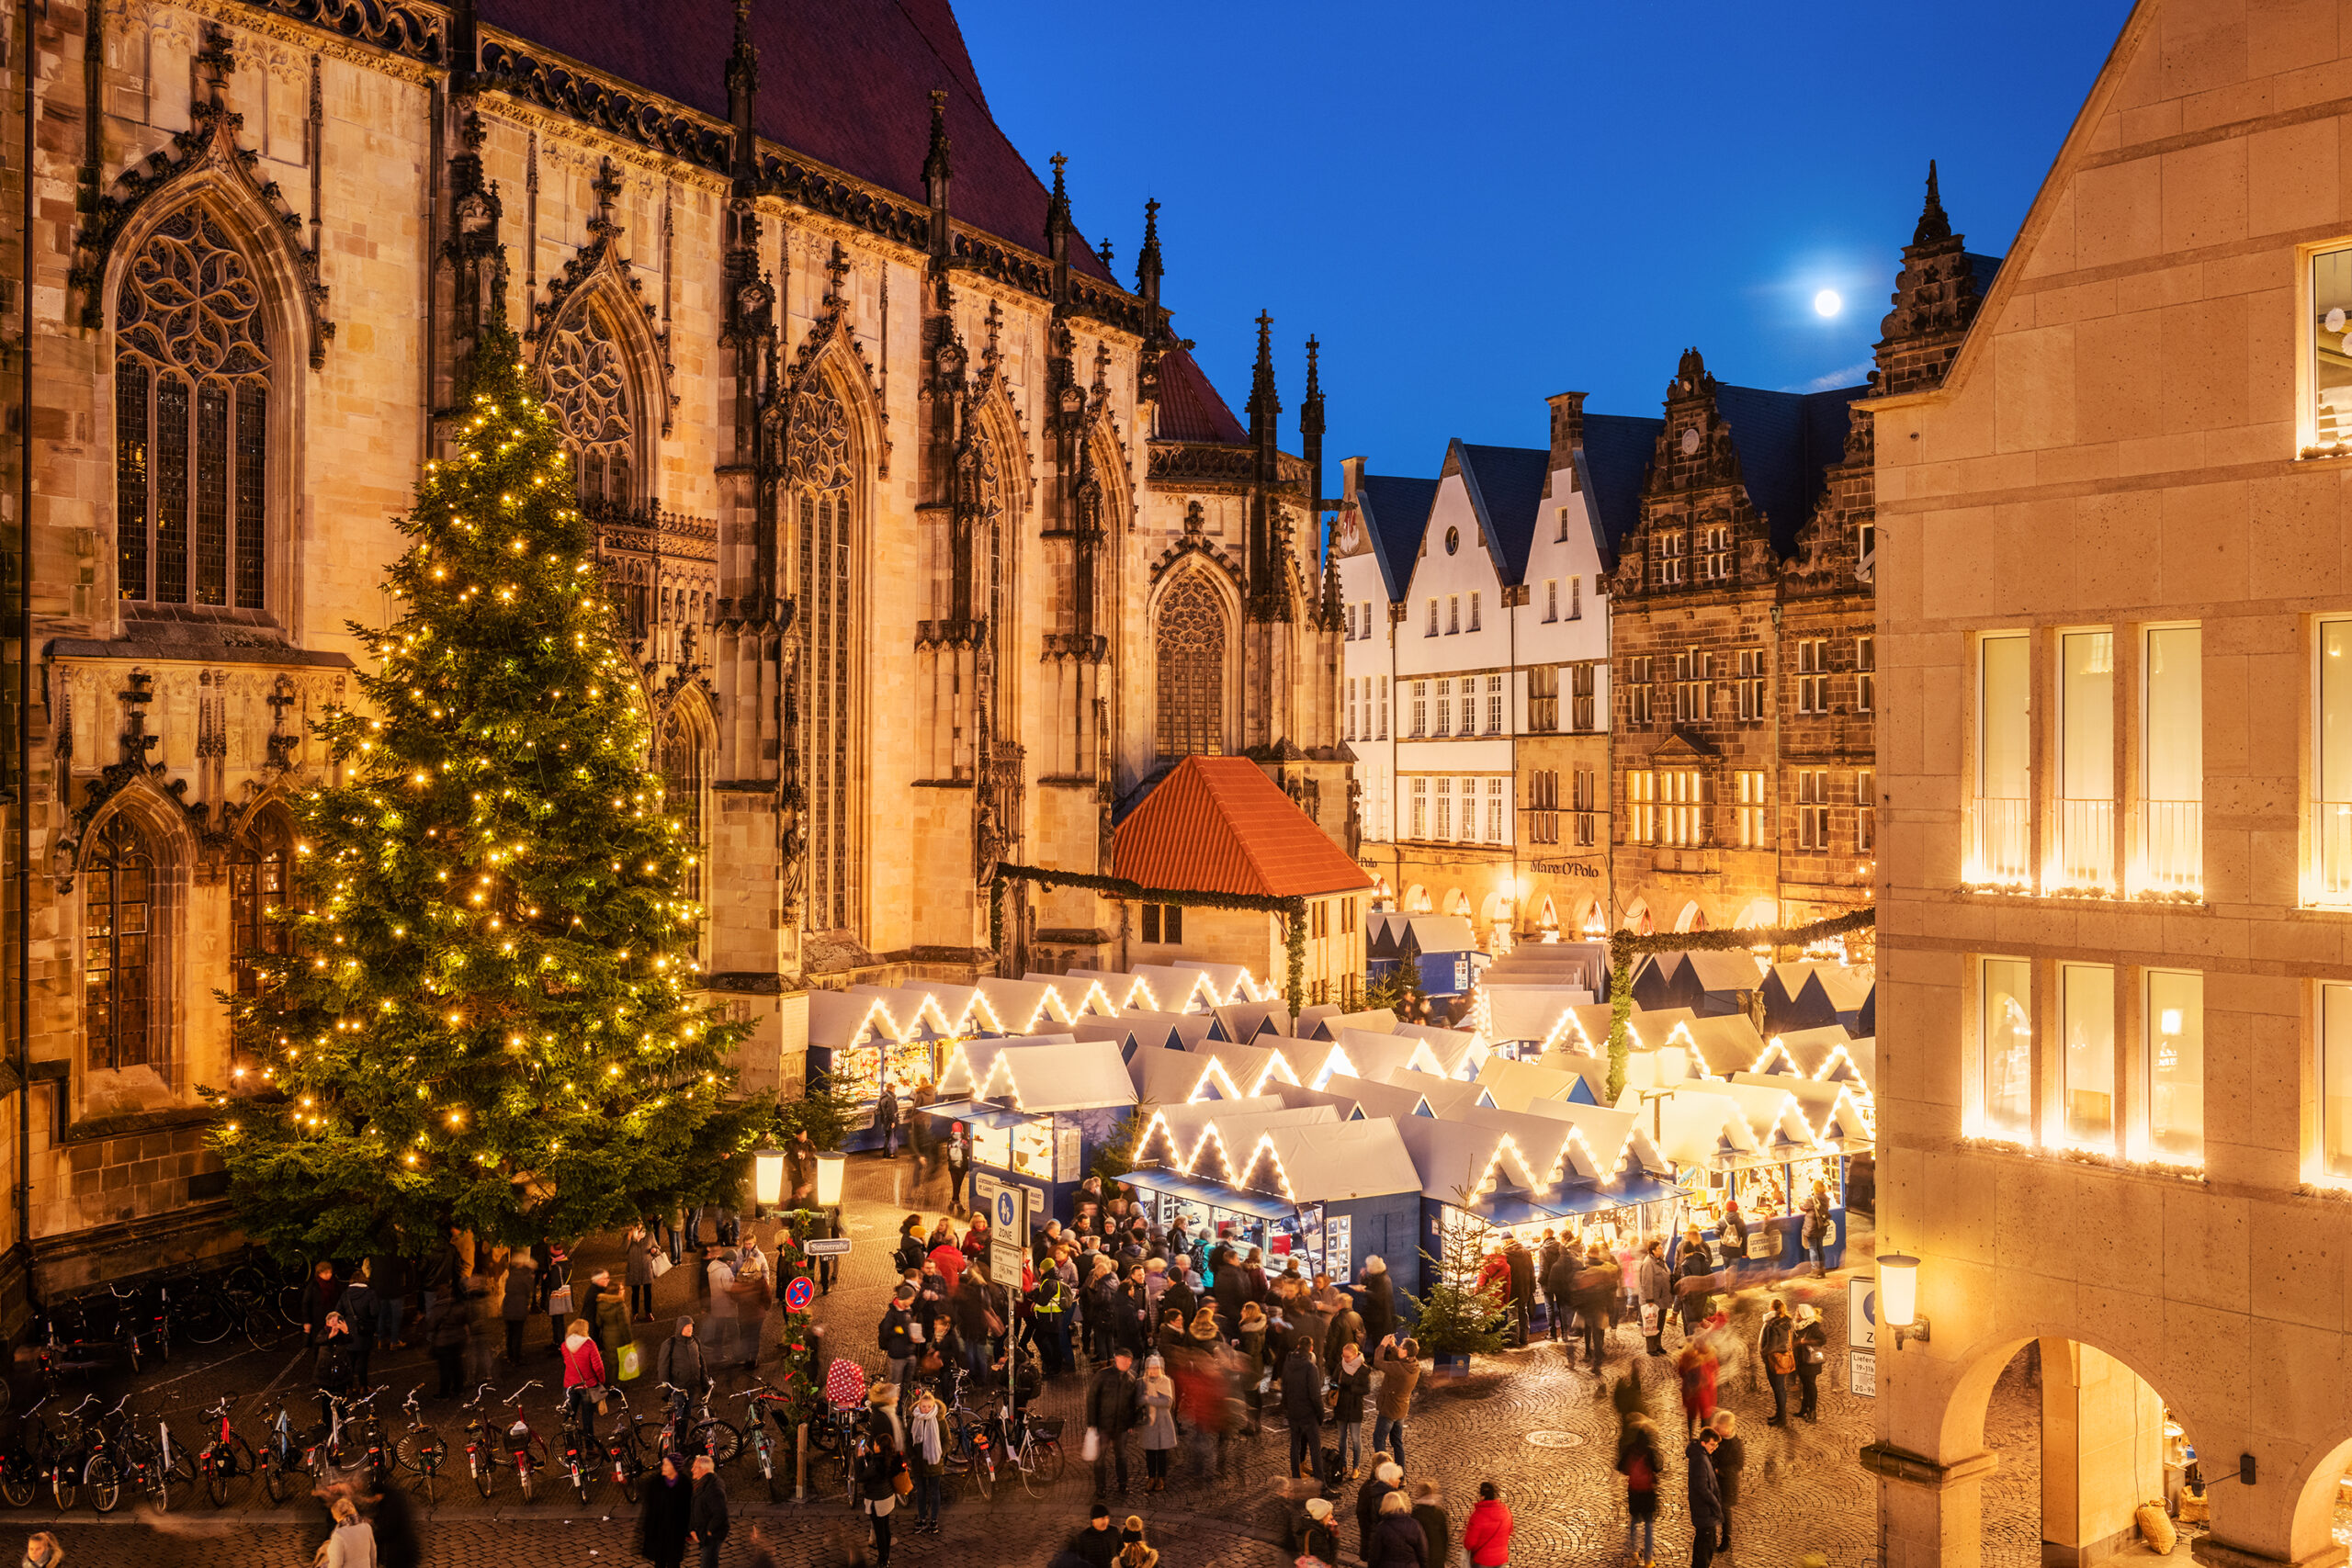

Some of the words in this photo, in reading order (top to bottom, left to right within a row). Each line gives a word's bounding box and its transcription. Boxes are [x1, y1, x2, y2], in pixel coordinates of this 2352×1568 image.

[1530, 861, 1559, 874] Marc
[1562, 862, 1600, 878] O'Polo
[998, 1227, 1012, 1241] ZONE
[1853, 1354, 1875, 1364] Lieferv
